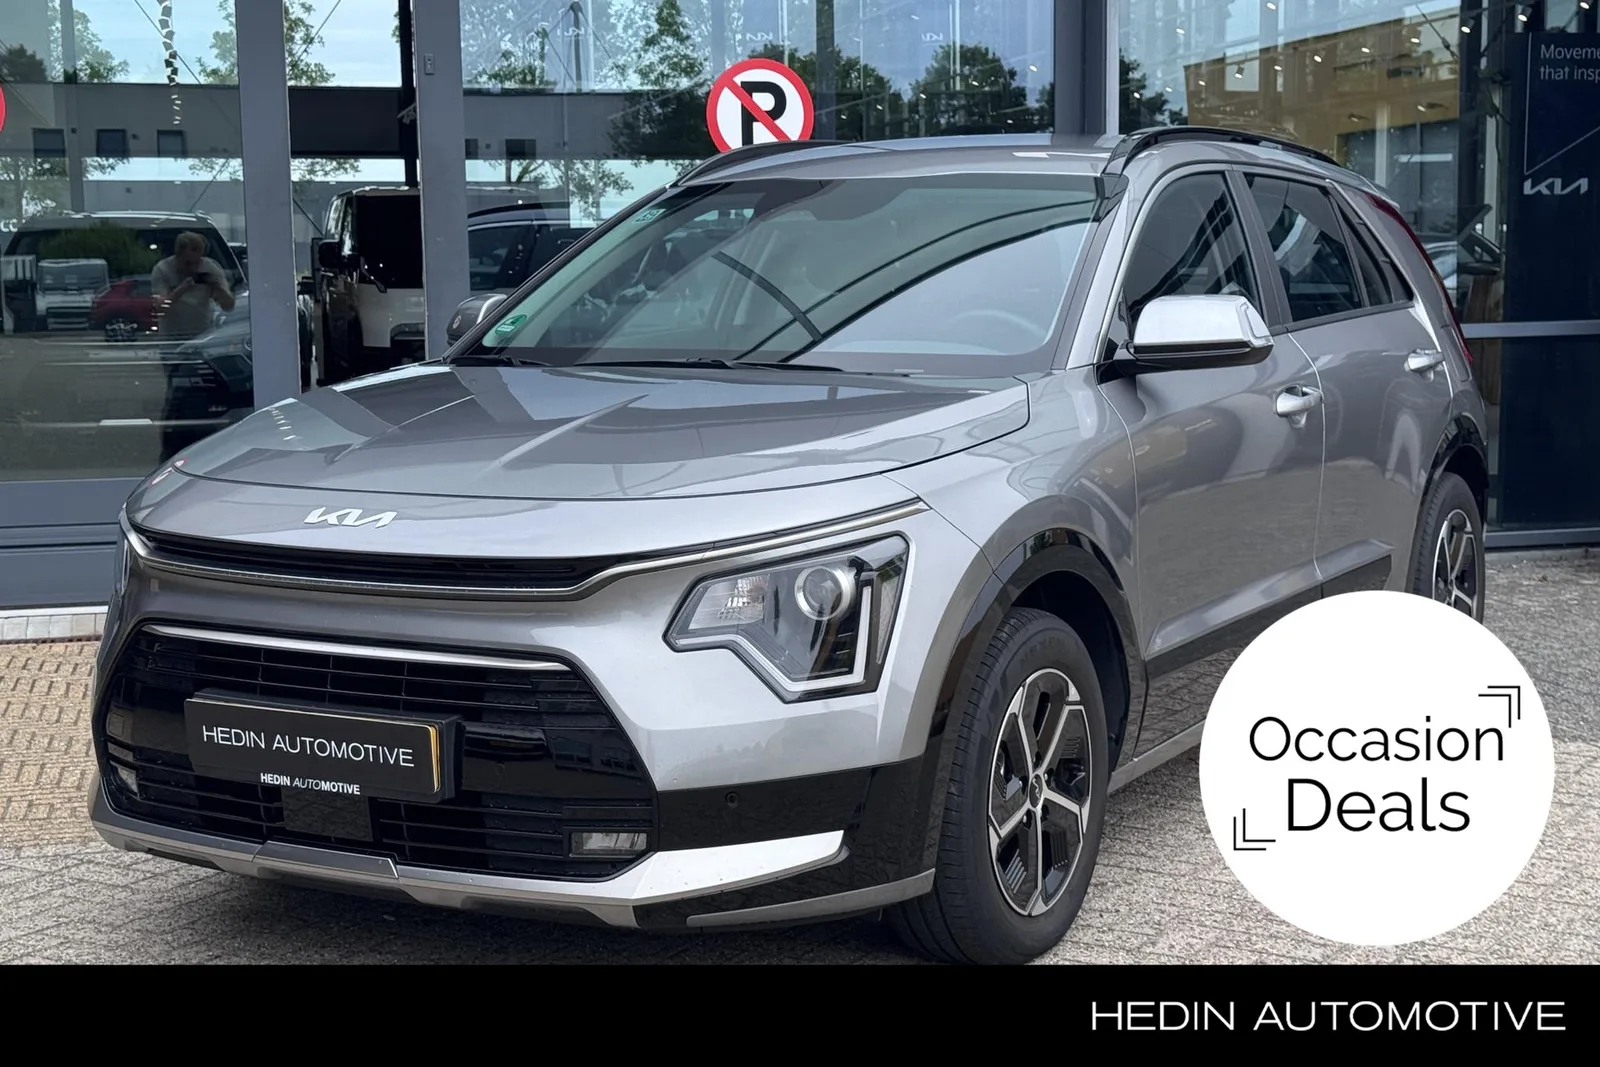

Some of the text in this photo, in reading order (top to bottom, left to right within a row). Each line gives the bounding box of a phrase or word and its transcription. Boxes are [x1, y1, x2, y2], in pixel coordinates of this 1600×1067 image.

[1540, 64, 1570, 81] that
[740, 81, 787, 147] P
[1523, 177, 1589, 195] KIA
[303, 506, 398, 529] KIA
[202, 725, 415, 767] HEDIN AUTOMOTIVE
[260, 772, 361, 795] HEDIN AUTOMOTIVE
